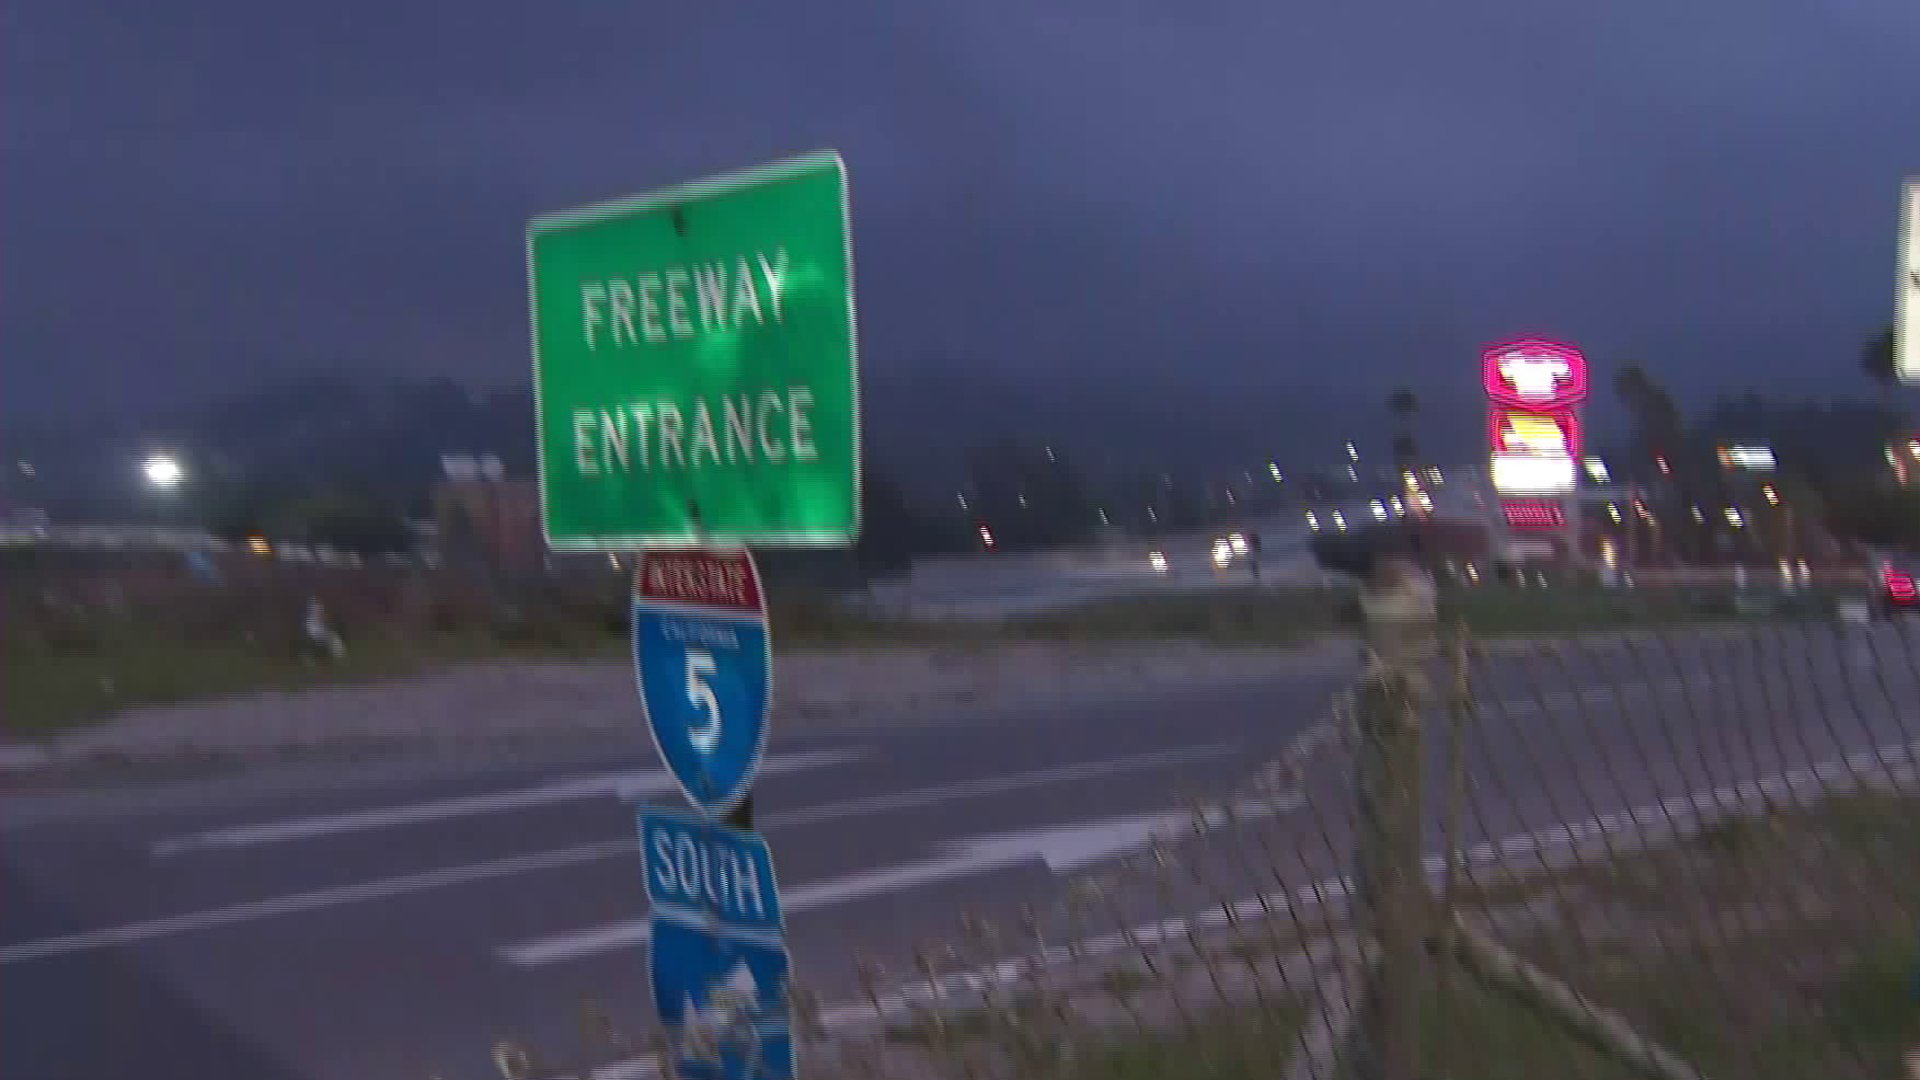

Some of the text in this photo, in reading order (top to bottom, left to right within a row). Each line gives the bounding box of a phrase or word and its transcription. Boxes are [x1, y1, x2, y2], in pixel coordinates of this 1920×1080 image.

[580, 250, 786, 349] FREEWAY
[572, 385, 818, 475] ENTRANCE
[685, 648, 720, 753] 5
[653, 828, 764, 918] SOUTH
